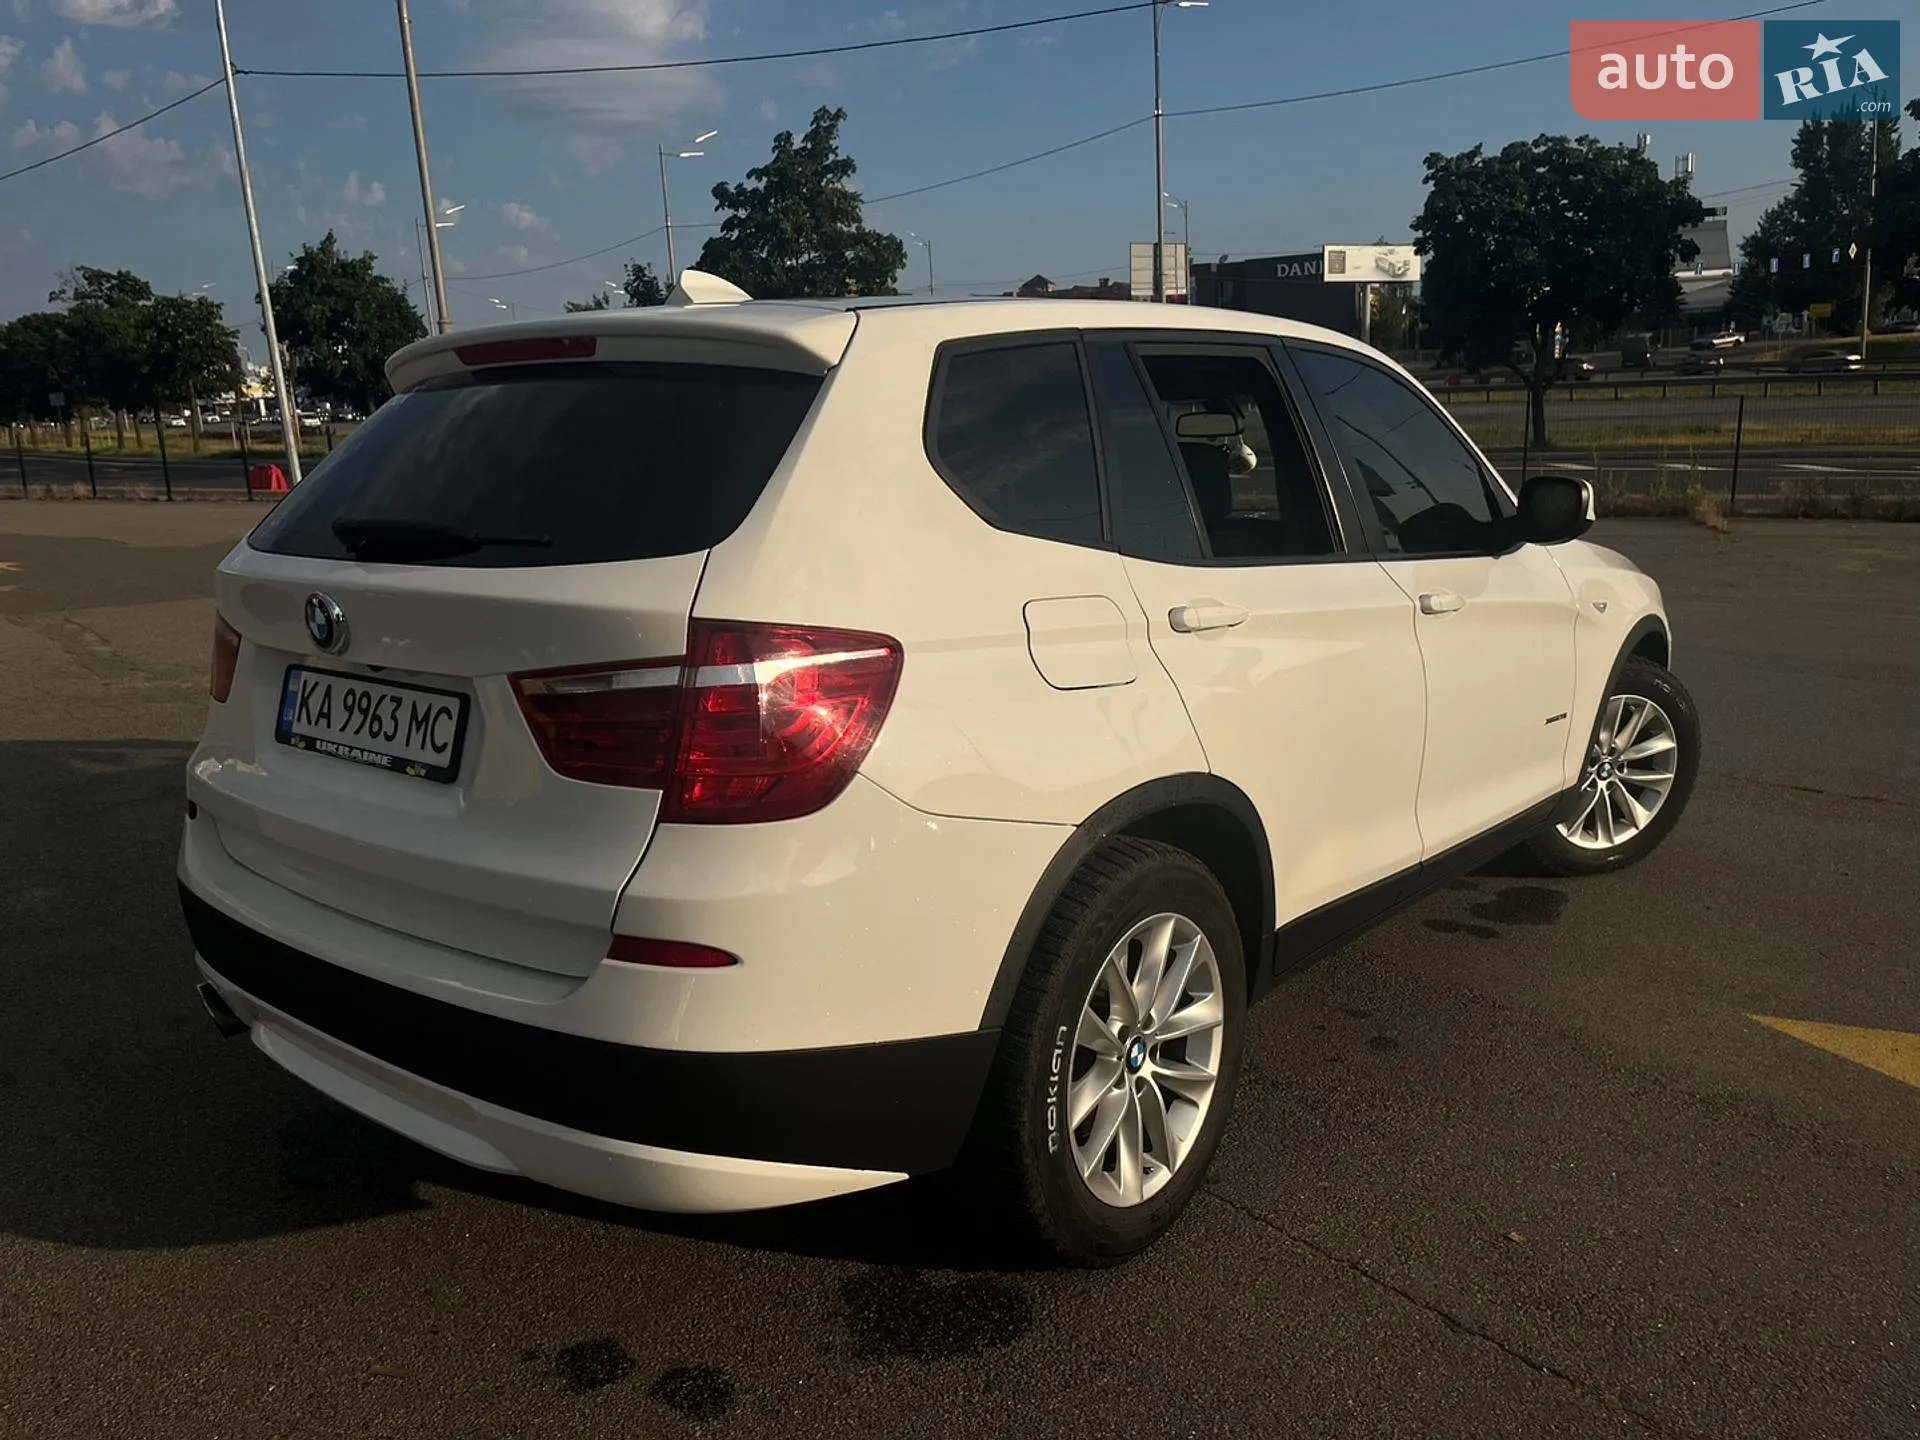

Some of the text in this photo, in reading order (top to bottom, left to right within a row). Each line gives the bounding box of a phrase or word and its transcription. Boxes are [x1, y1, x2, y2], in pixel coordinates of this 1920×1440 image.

[297, 679, 453, 753] KA 9963 MC
[316, 740, 392, 766] UKRAINE
